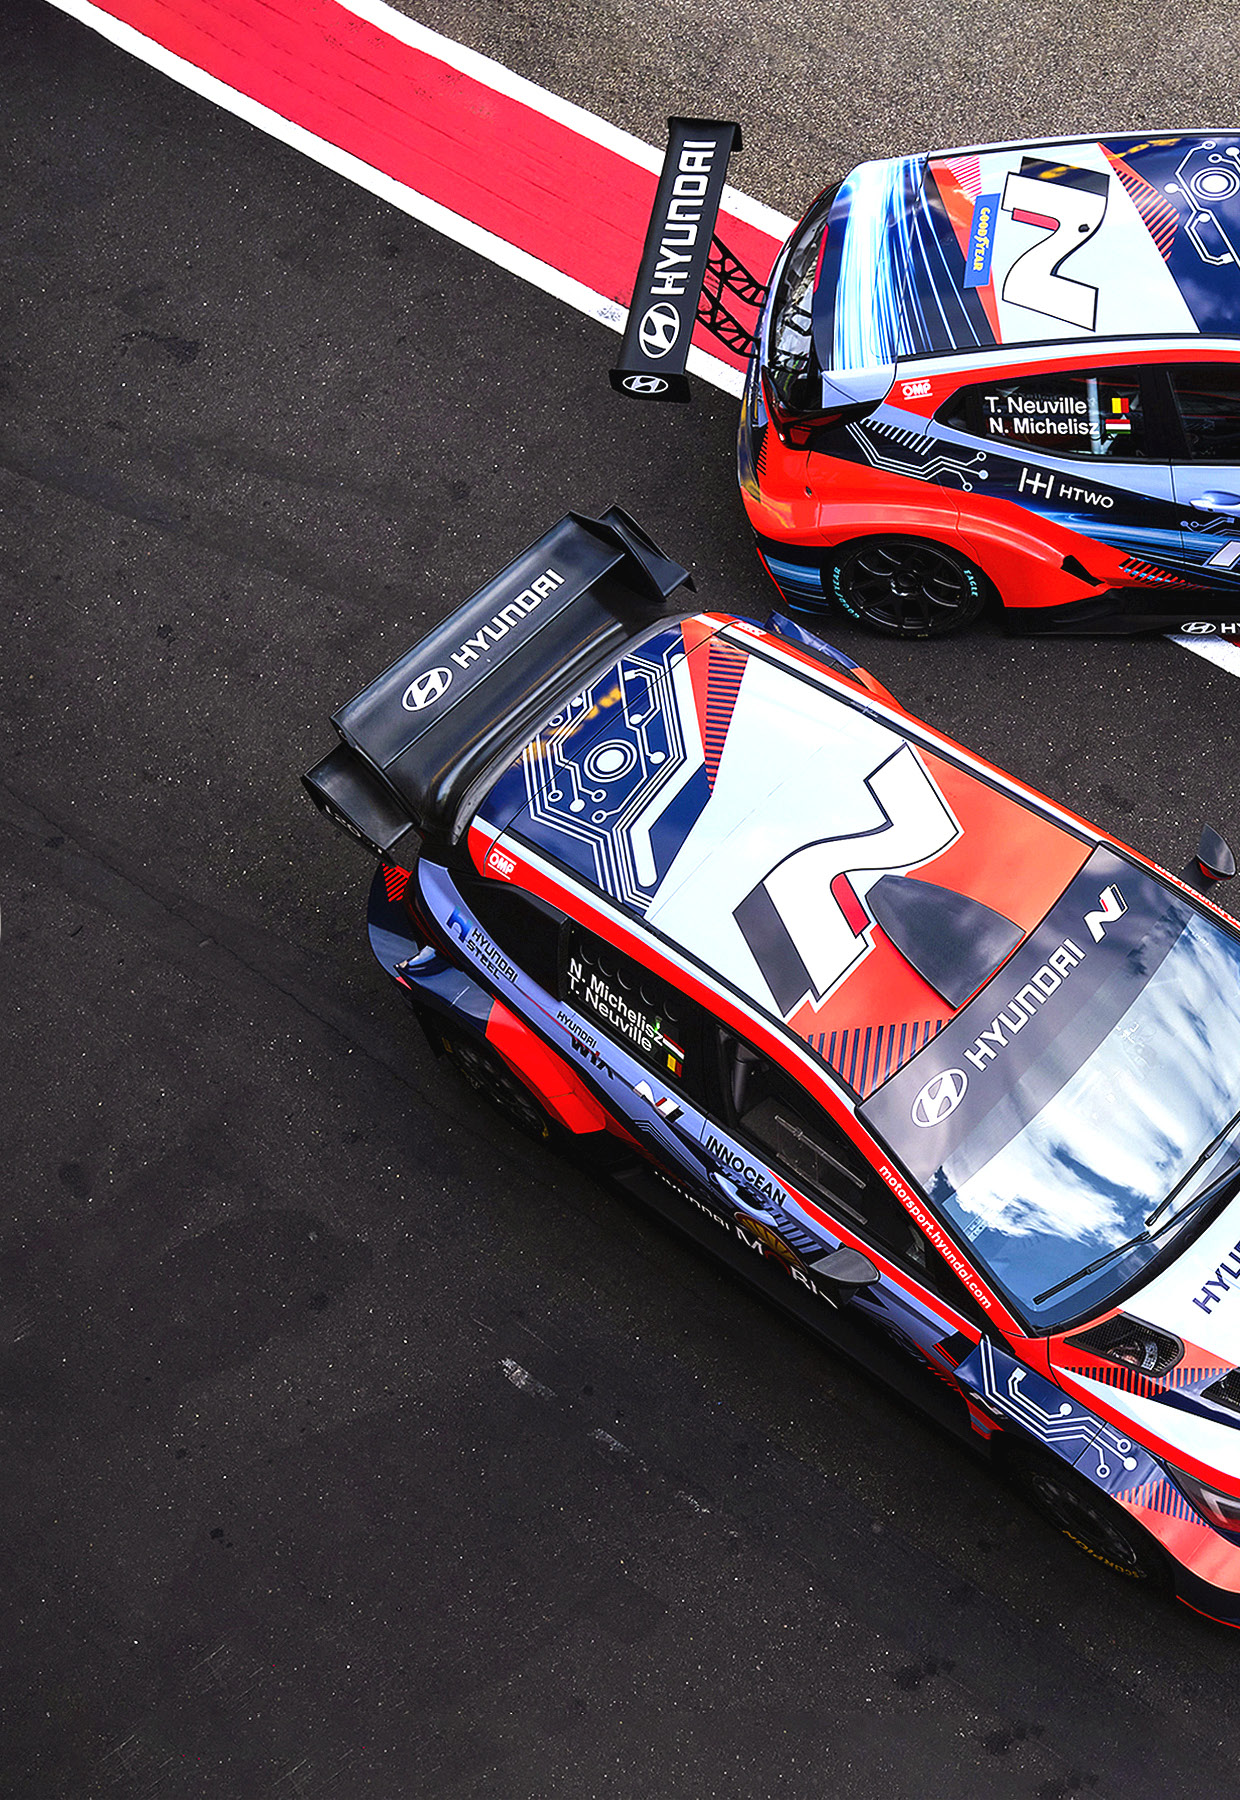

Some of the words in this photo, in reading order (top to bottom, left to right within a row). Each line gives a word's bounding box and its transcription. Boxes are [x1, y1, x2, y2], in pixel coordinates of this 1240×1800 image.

[650, 140, 717, 295] HYUNDAI
[973, 207, 991, 272] GOODYEAR
[902, 382, 932, 397] OMP
[985, 397, 1001, 413] T.
[1008, 397, 1087, 414] Neuville
[990, 417, 1009, 434] N.
[1013, 418, 1100, 435] Michelisz
[1059, 484, 1114, 508] HTWO
[963, 569, 979, 597] EAGLE
[450, 568, 566, 670] HYUNDAI
[489, 852, 515, 875] OMP
[466, 939, 501, 980] STEEL
[472, 928, 518, 983] HYUNDAI
[557, 1010, 598, 1049] HYUNDAI
[567, 972, 580, 995] T.
[585, 987, 653, 1052] Neuville
[570, 958, 586, 983] N.
[590, 974, 665, 1047] Michelisz
[963, 938, 1087, 1072] HYUNDAI
[705, 1134, 787, 1208] INNOCEAN
[879, 1165, 992, 1309] motorsport.hyundai.com
